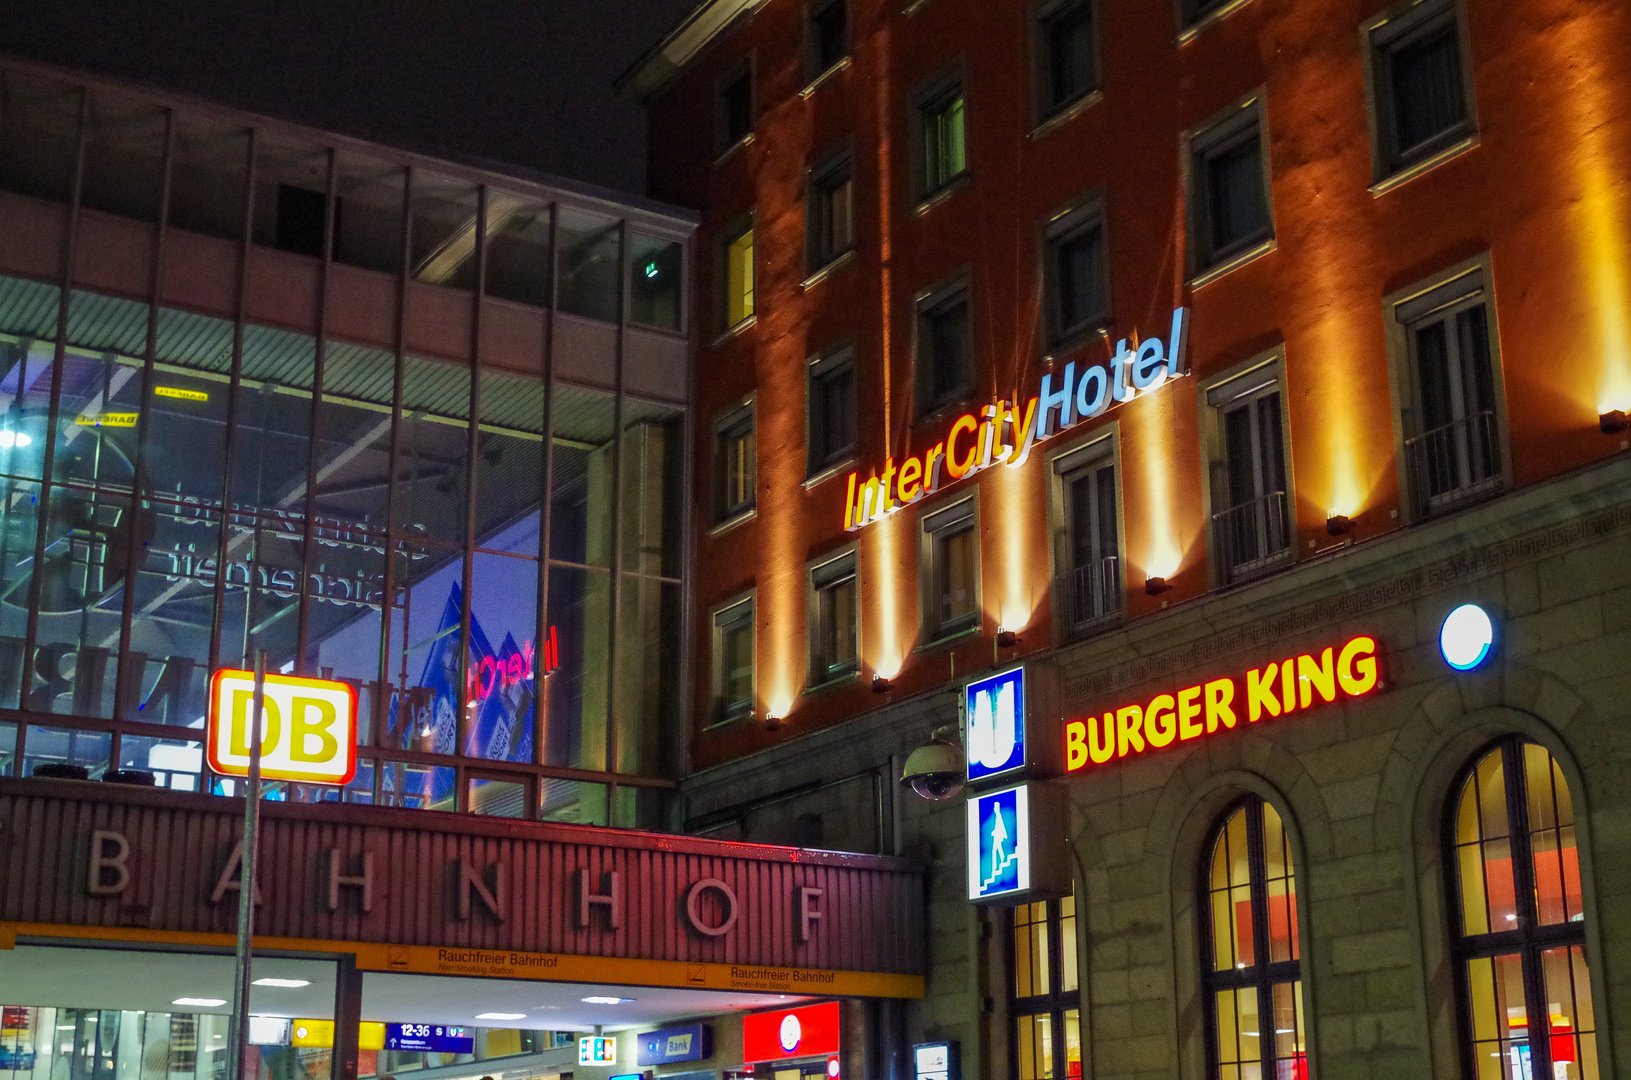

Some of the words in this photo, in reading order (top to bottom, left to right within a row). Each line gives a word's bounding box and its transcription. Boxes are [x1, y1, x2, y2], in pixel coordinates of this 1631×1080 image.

[844, 306, 1188, 531] InterCityHotel
[1066, 678, 1237, 771] BURGER
[1247, 637, 1377, 722] KING
[230, 689, 338, 763] DB
[973, 681, 1015, 768] U
[438, 949, 506, 965] Rauchfreier
[510, 953, 558, 968] Bahnhof
[489, 965, 514, 974] Station
[731, 967, 790, 981] Rauchfreier
[793, 970, 835, 984] Bahnhof
[769, 980, 790, 989] Station
[401, 1024, 430, 1037] 12-36
[669, 1039, 688, 1052] Bank
